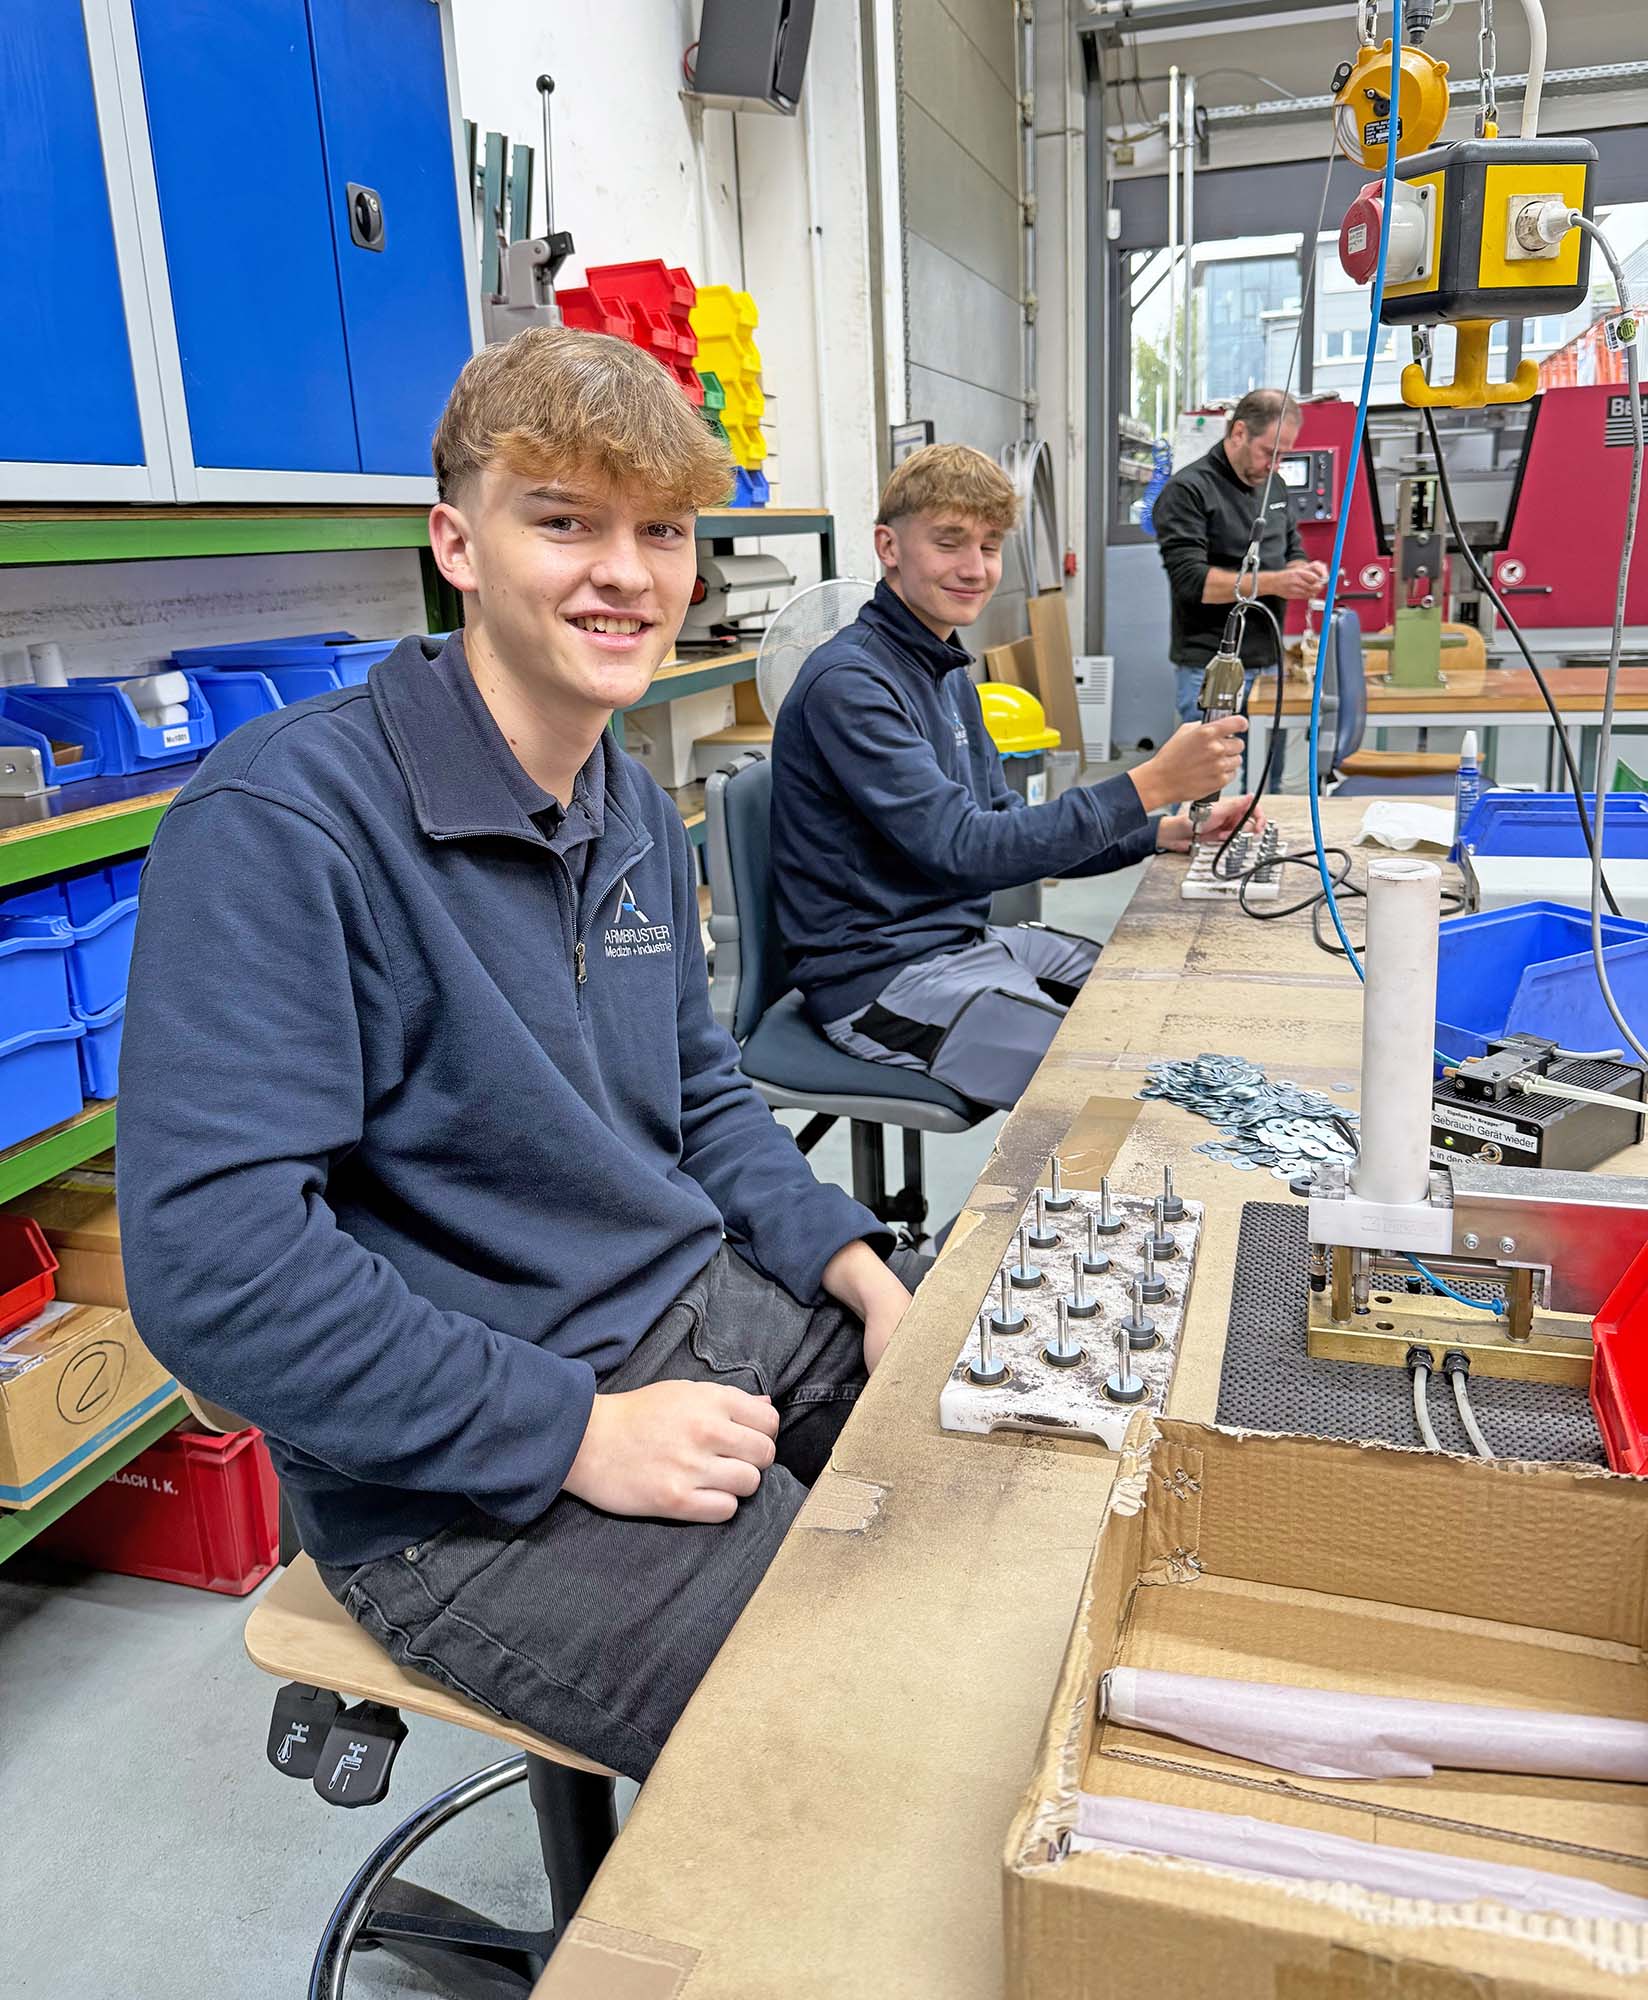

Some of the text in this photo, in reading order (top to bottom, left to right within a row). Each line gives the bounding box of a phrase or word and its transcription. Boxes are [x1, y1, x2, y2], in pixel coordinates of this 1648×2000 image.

[604, 925, 670, 944] ARMBRUSTER
[604, 945, 632, 957] Medizin
[637, 941, 672, 955] Industrie
[1432, 1113, 1535, 1149] Gebrauch Gerät wieder
[73, 1352, 109, 1413] 2
[109, 1472, 148, 1489] LACH
